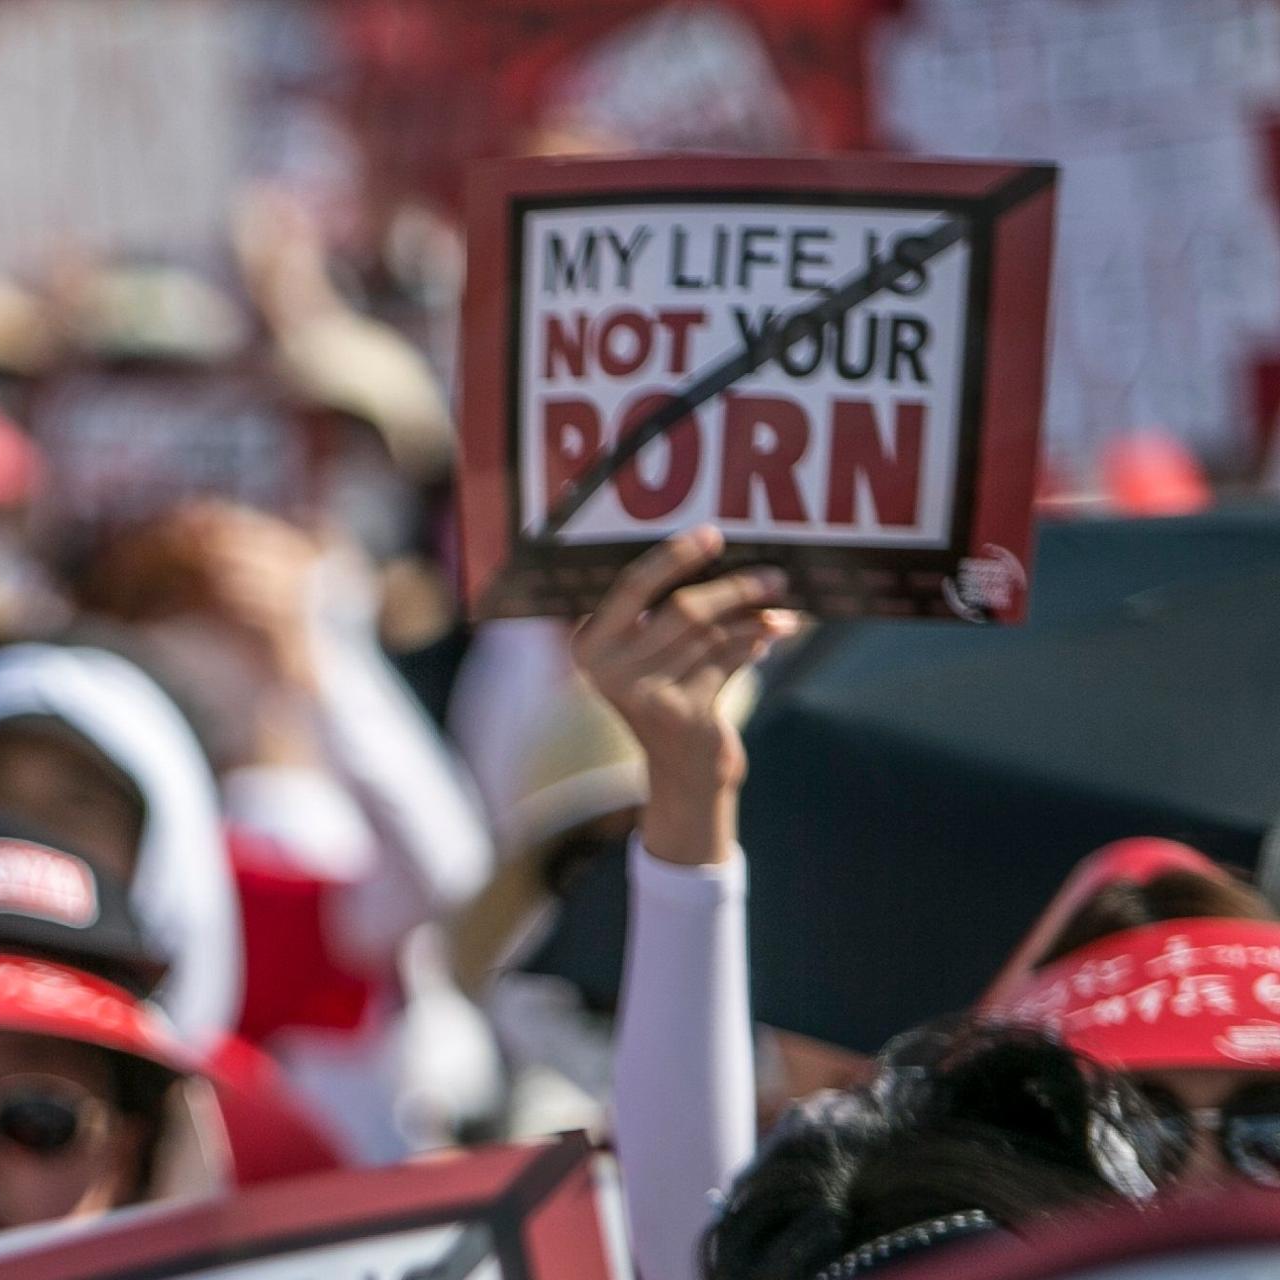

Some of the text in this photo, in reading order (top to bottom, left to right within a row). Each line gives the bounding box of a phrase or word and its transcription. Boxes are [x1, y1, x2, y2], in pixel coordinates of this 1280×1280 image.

[544, 224, 927, 295] MY LIFE IS
[546, 306, 929, 384] NOT YOUR
[544, 392, 928, 527] PORN
